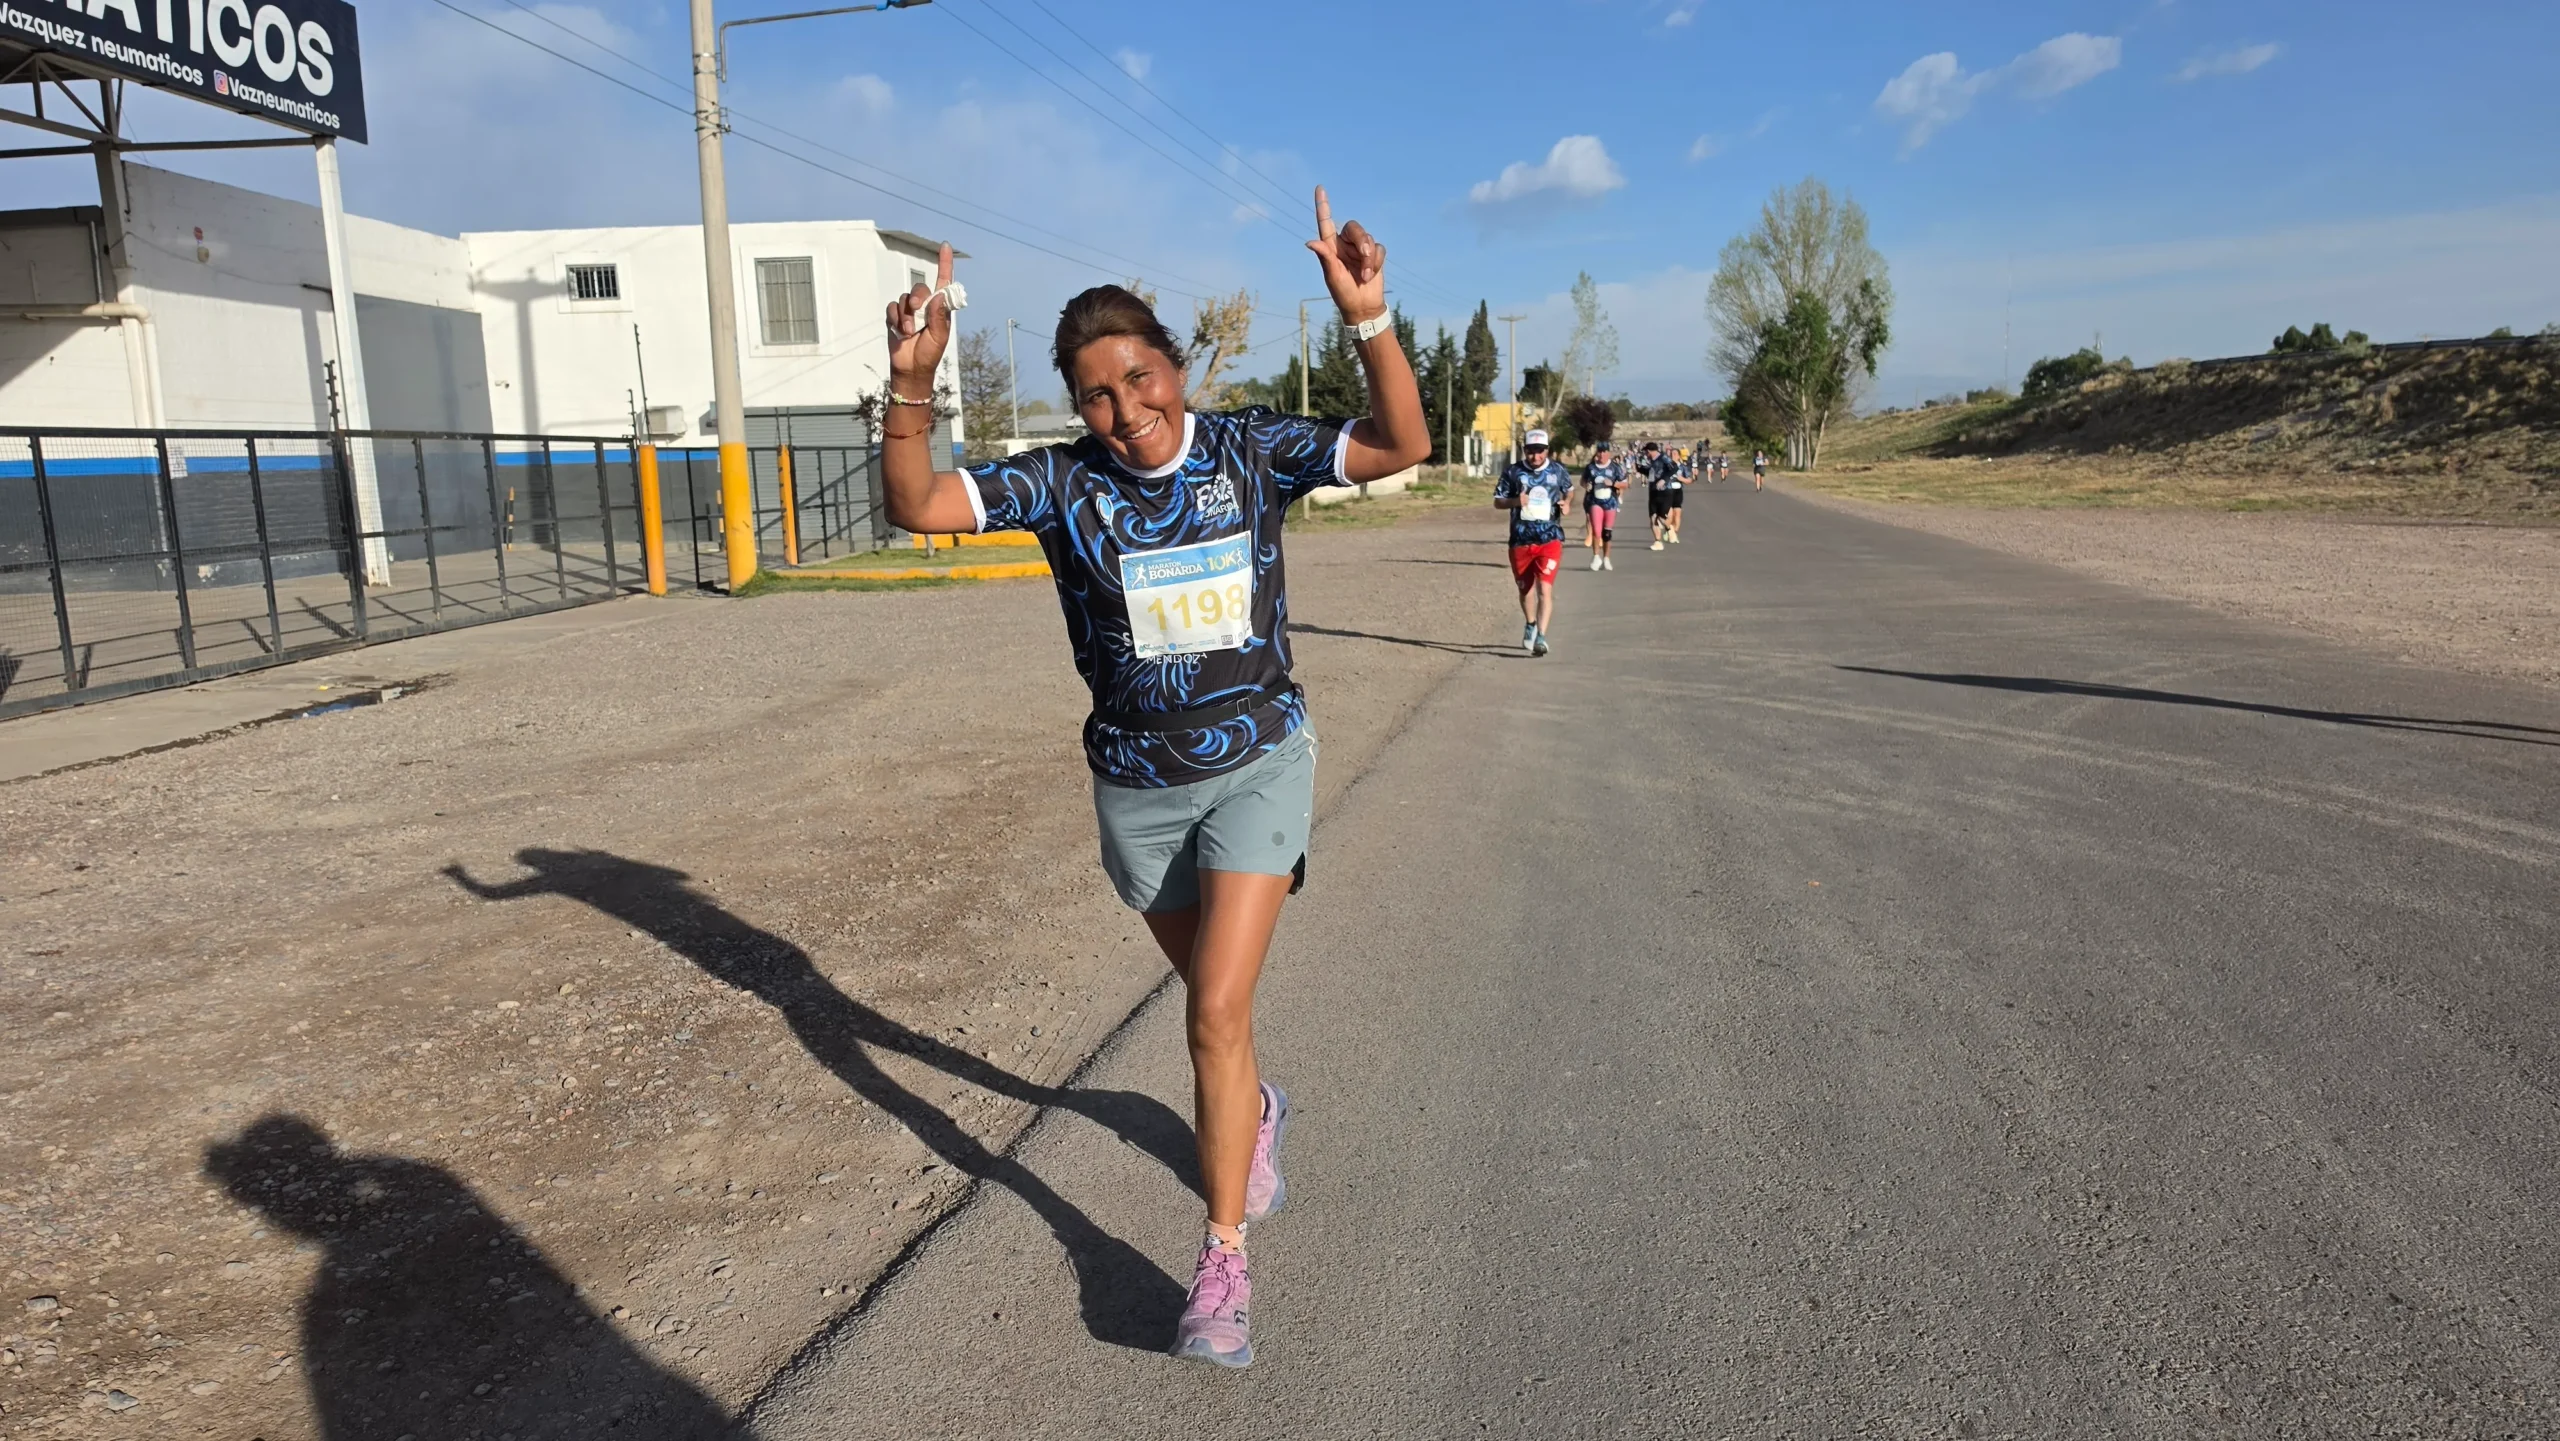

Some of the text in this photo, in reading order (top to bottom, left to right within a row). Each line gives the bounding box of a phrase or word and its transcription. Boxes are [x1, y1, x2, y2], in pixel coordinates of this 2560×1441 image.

[0, 2, 204, 86] Vazquez neumaticos
[46, 0, 334, 97] ICOS
[229, 76, 340, 129] Vazneumaticos
[1149, 563, 1205, 580] BONARDA
[1147, 583, 1245, 631] 1198
